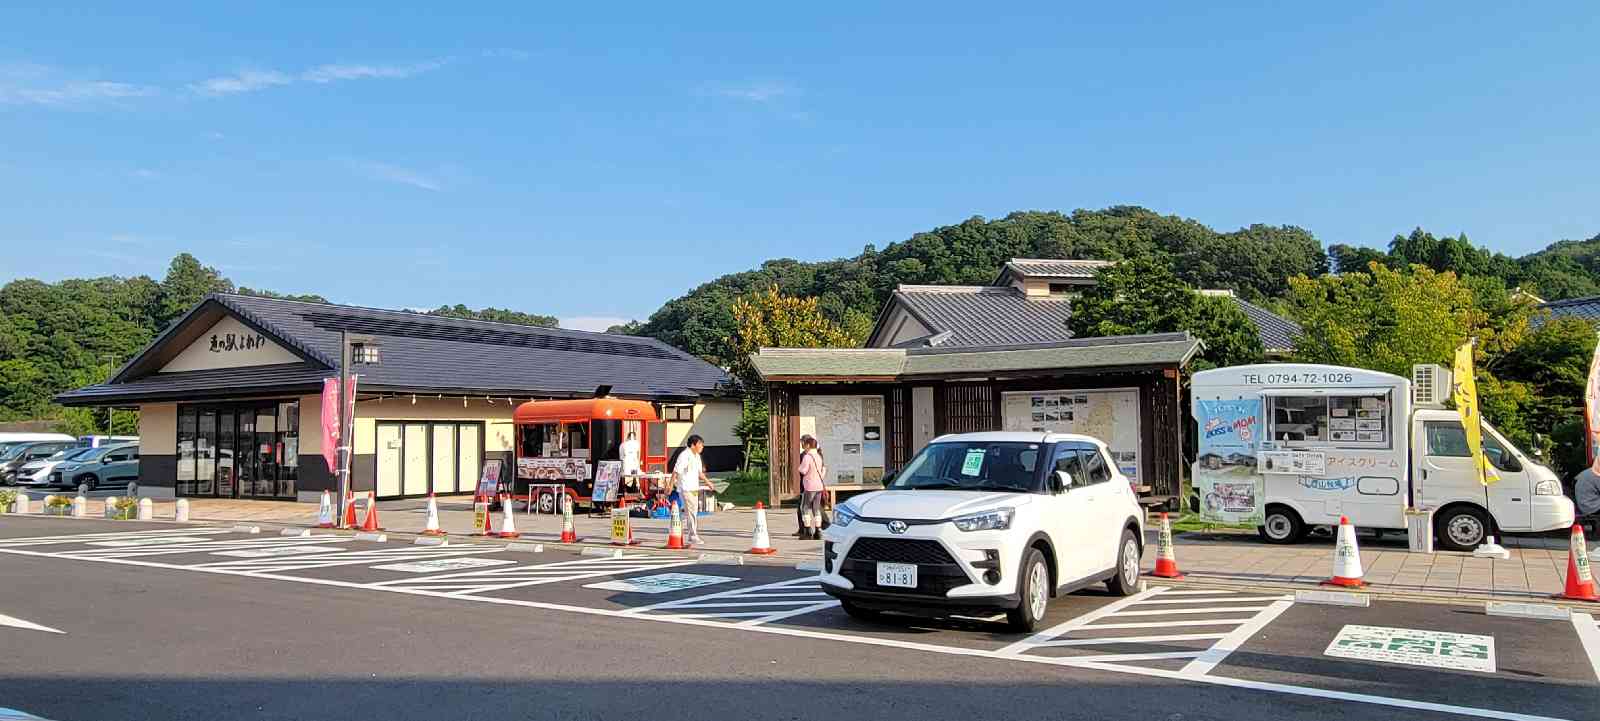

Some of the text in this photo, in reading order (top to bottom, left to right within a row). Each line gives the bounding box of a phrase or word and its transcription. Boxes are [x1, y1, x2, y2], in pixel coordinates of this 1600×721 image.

[1243, 374, 1264, 384] TEL
[1327, 456, 1399, 468] アイスクリーム
